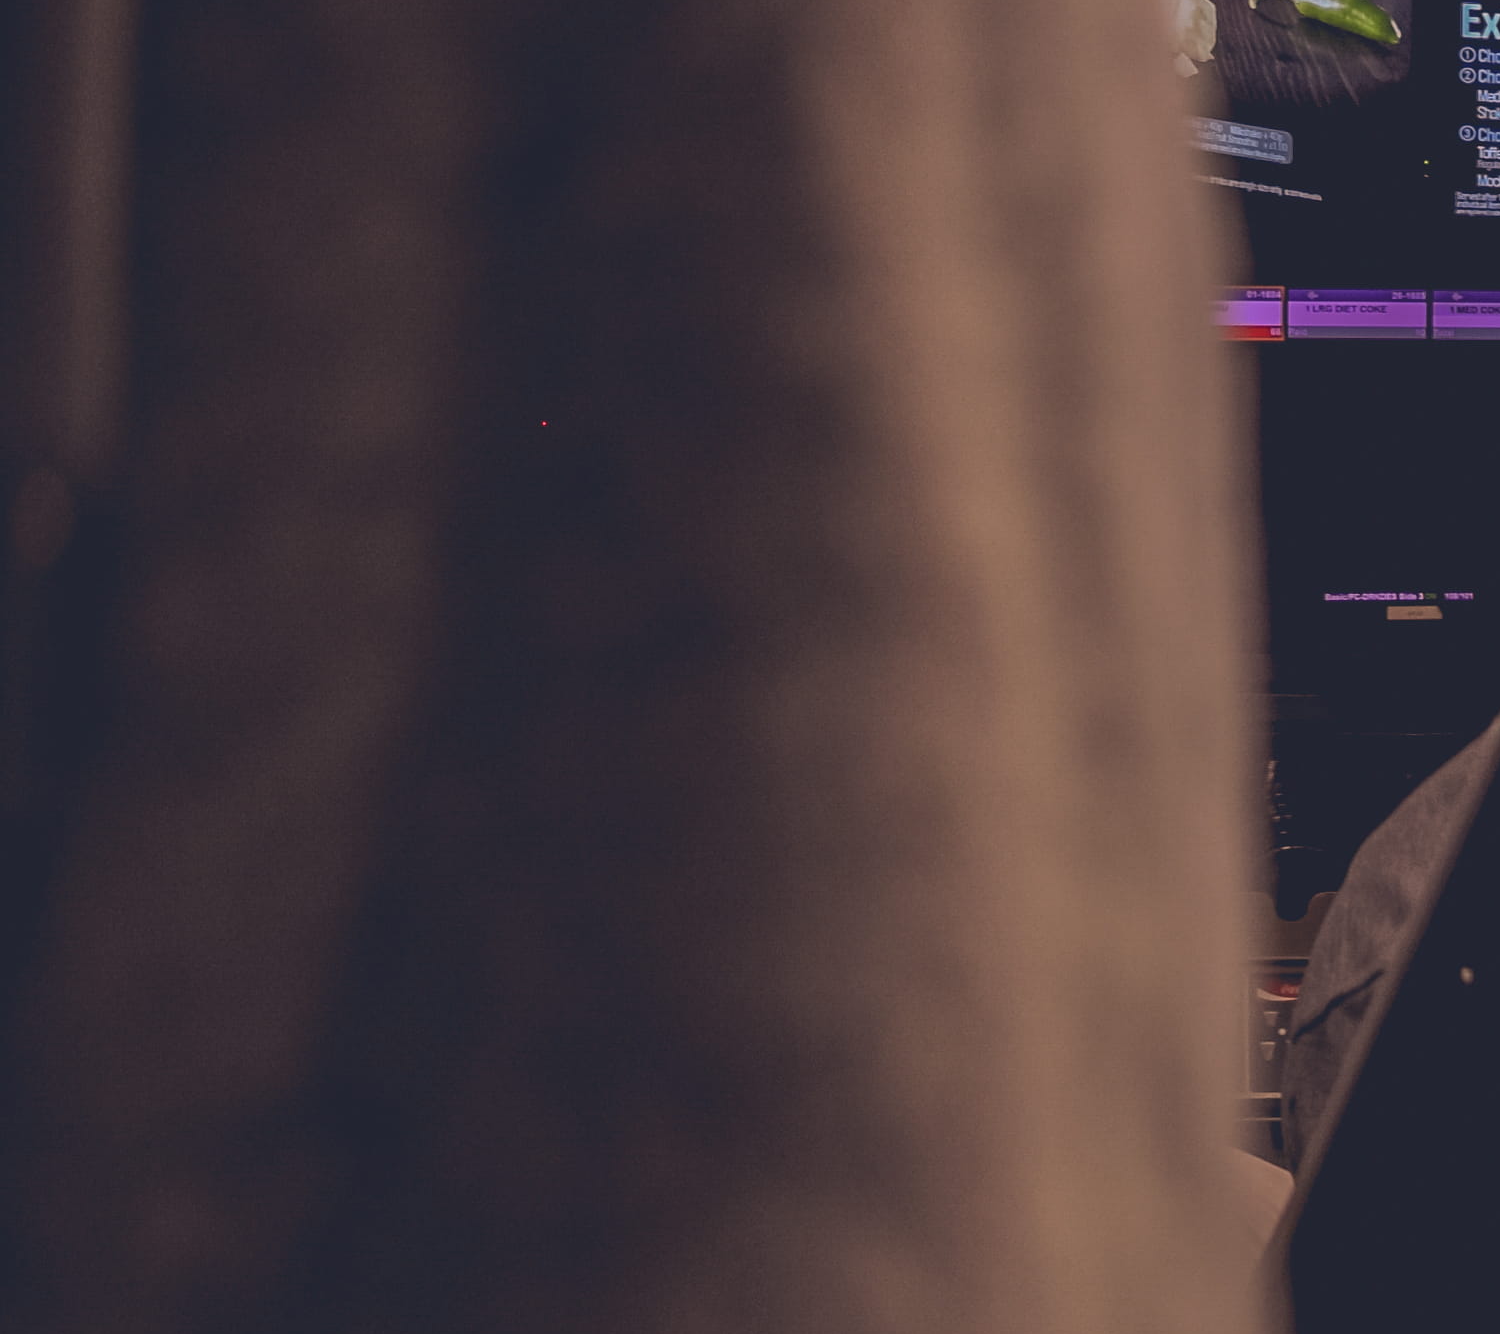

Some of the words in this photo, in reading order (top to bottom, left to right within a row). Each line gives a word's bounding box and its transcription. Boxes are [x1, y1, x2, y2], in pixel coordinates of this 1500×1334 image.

[1312, 305, 1333, 314] LRG
[1336, 305, 1357, 314] DIET
[1359, 305, 1388, 315] COKE
[1456, 307, 1479, 315] MED
